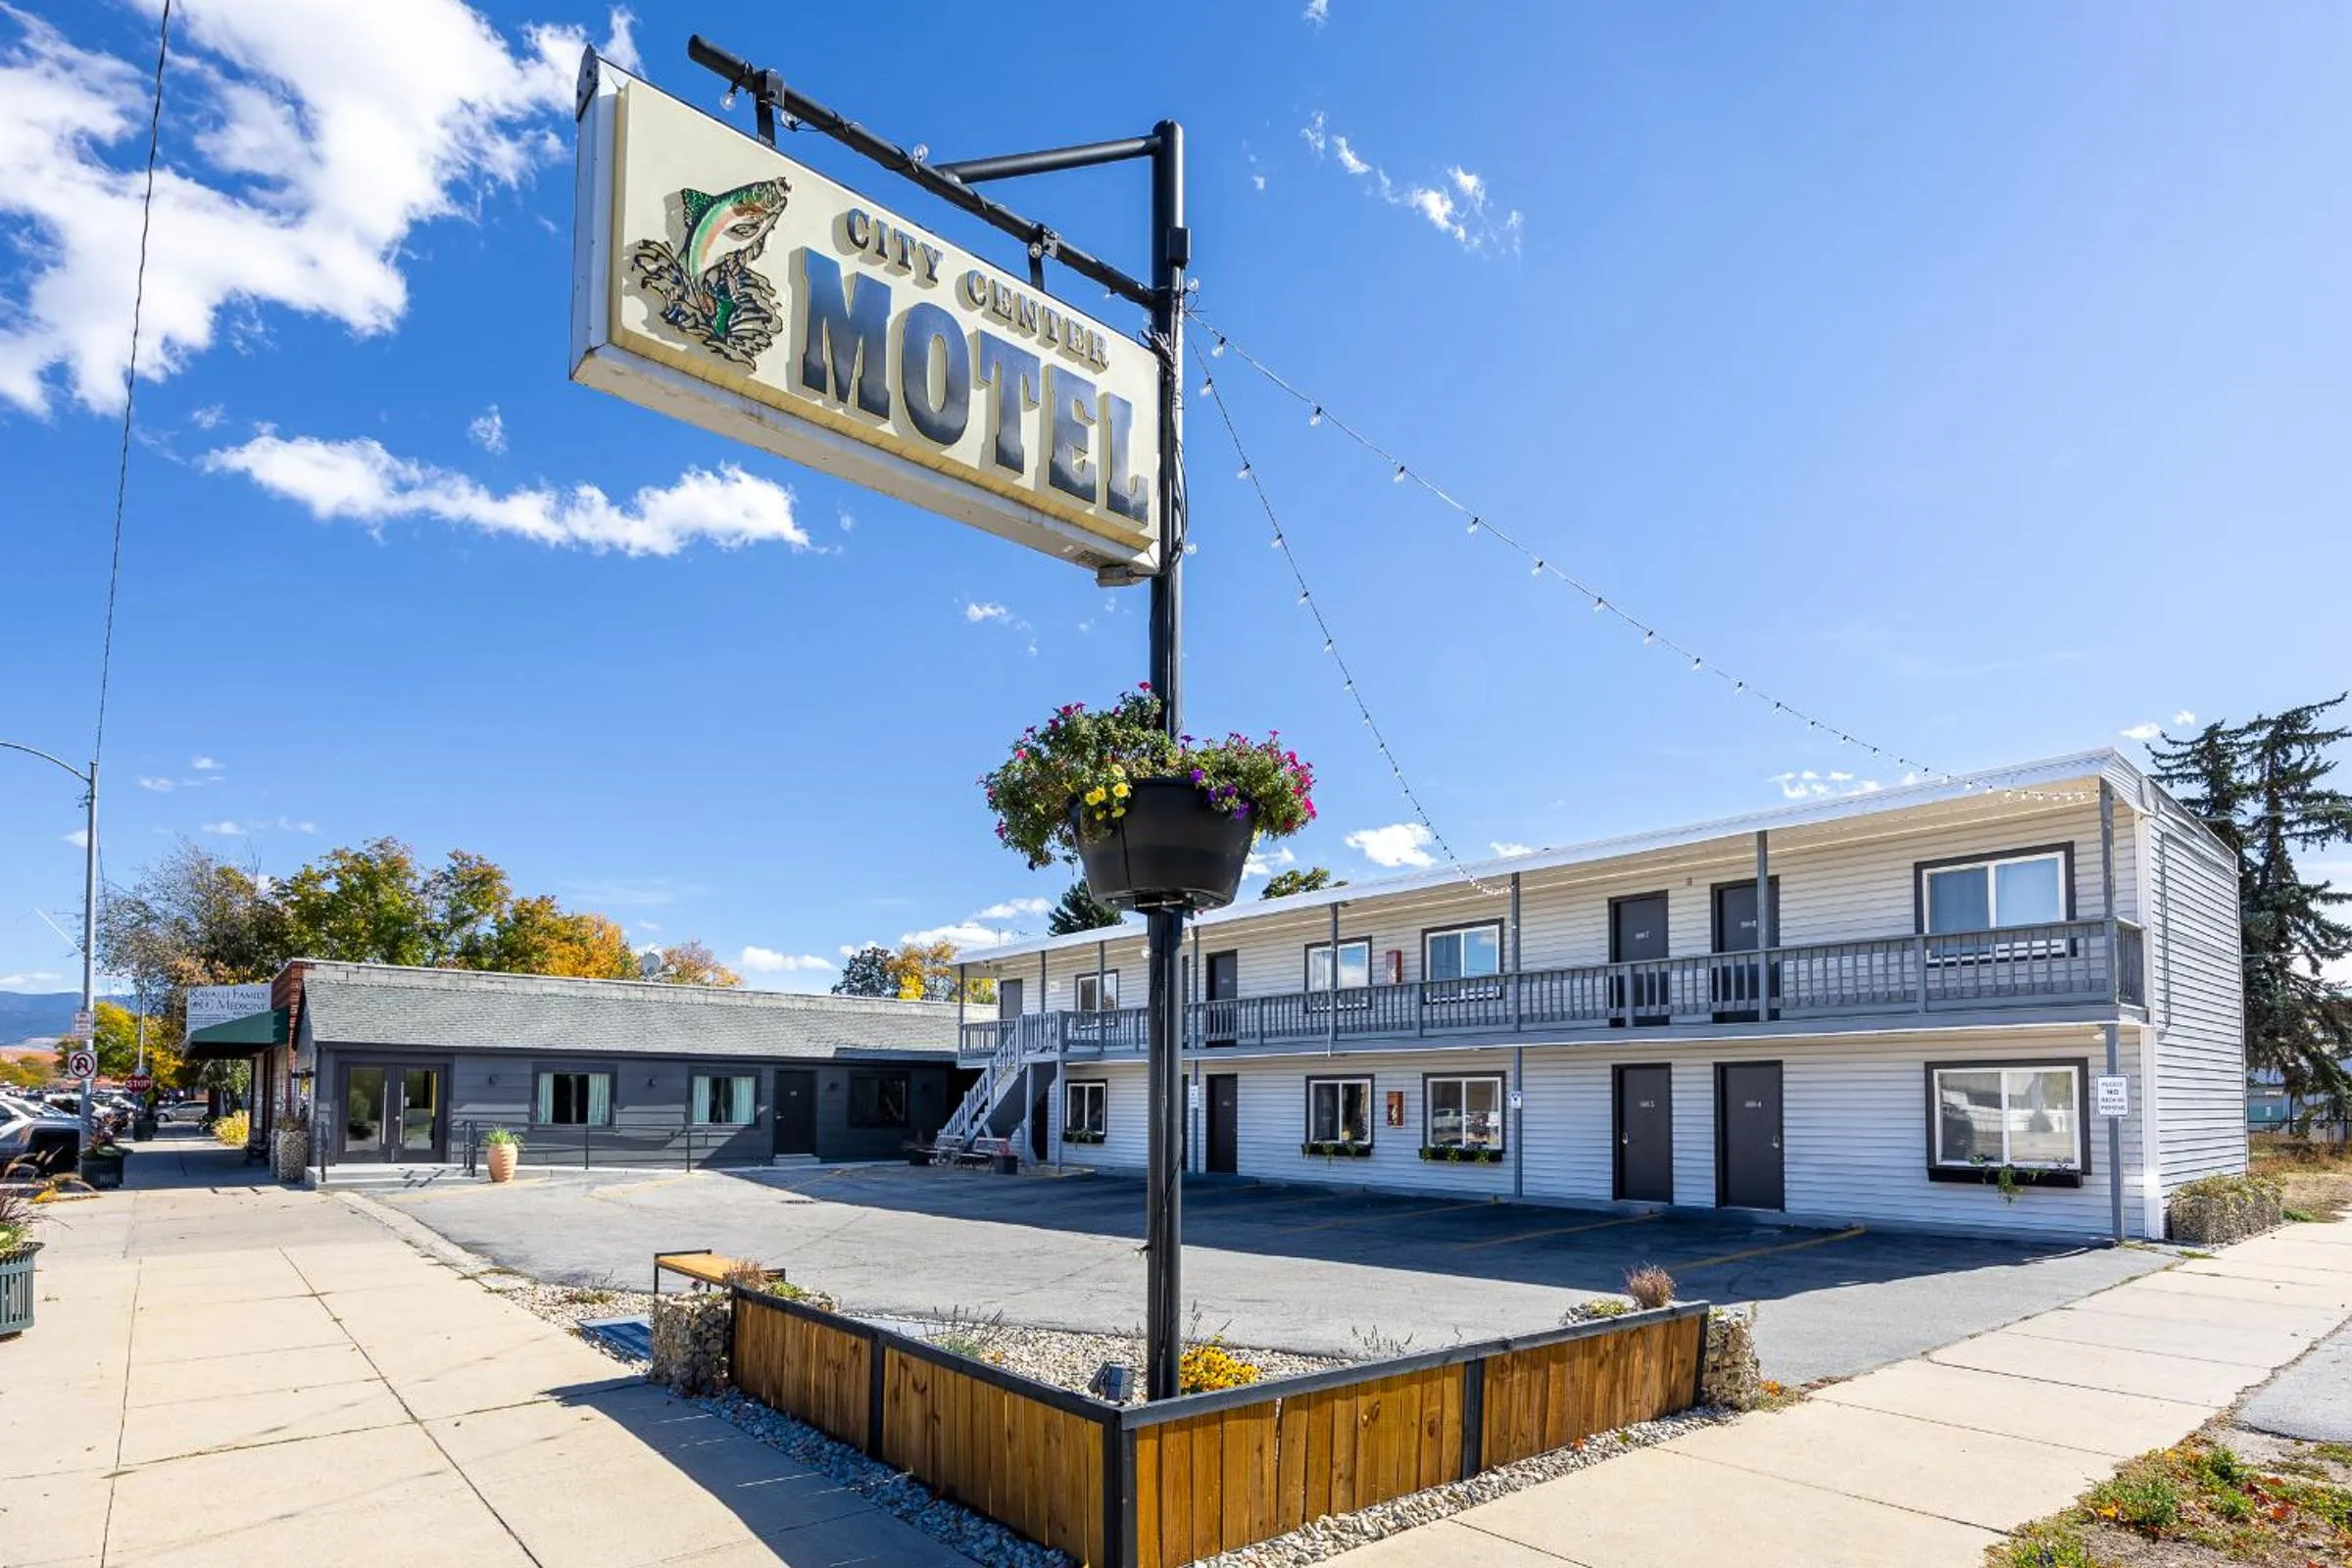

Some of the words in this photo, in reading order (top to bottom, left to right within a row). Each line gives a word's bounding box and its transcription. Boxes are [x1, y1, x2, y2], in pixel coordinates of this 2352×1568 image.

[847, 208, 943, 283] CITY
[964, 270, 1109, 368] CENTER
[803, 247, 1148, 525] MOTEL
[126, 1079, 150, 1088] STOP
